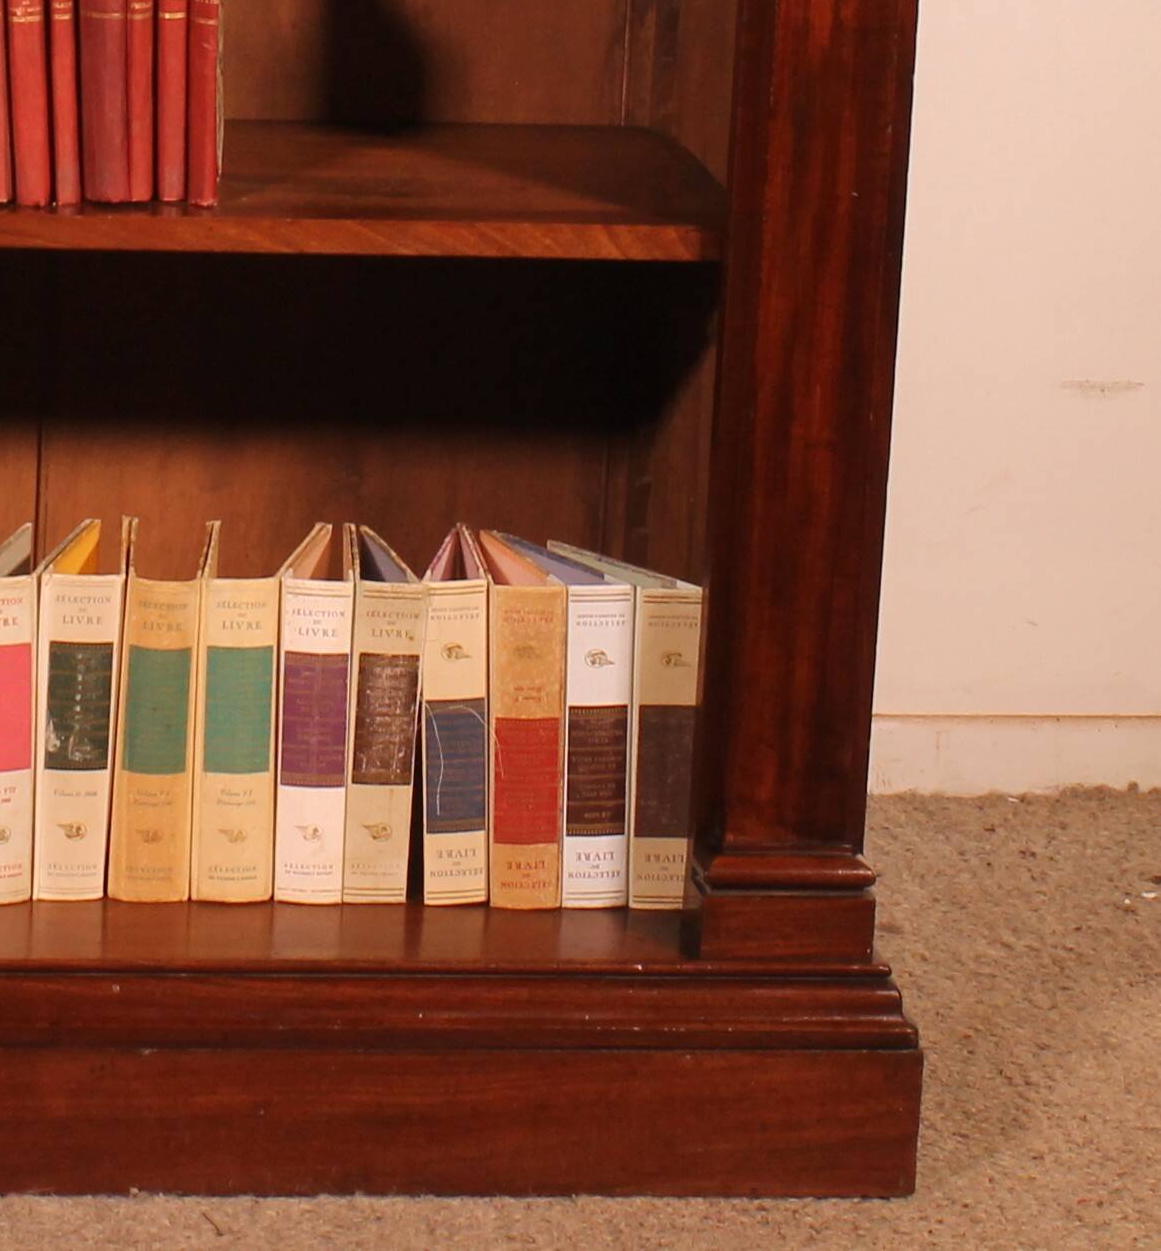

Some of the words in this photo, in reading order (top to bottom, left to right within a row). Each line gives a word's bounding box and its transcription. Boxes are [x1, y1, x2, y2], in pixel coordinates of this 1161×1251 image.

[62, 614, 103, 625] LIVRE
[143, 622, 183, 632] LIVRE
[222, 621, 262, 630] LIVRE
[298, 627, 339, 638] LIVRE
[435, 848, 476, 859] LIVRE
[575, 851, 614, 862] LIVRE
[644, 853, 684, 863] LIVRE
[506, 860, 545, 870] LIVRE
[637, 873, 685, 881] ÉLECTION
